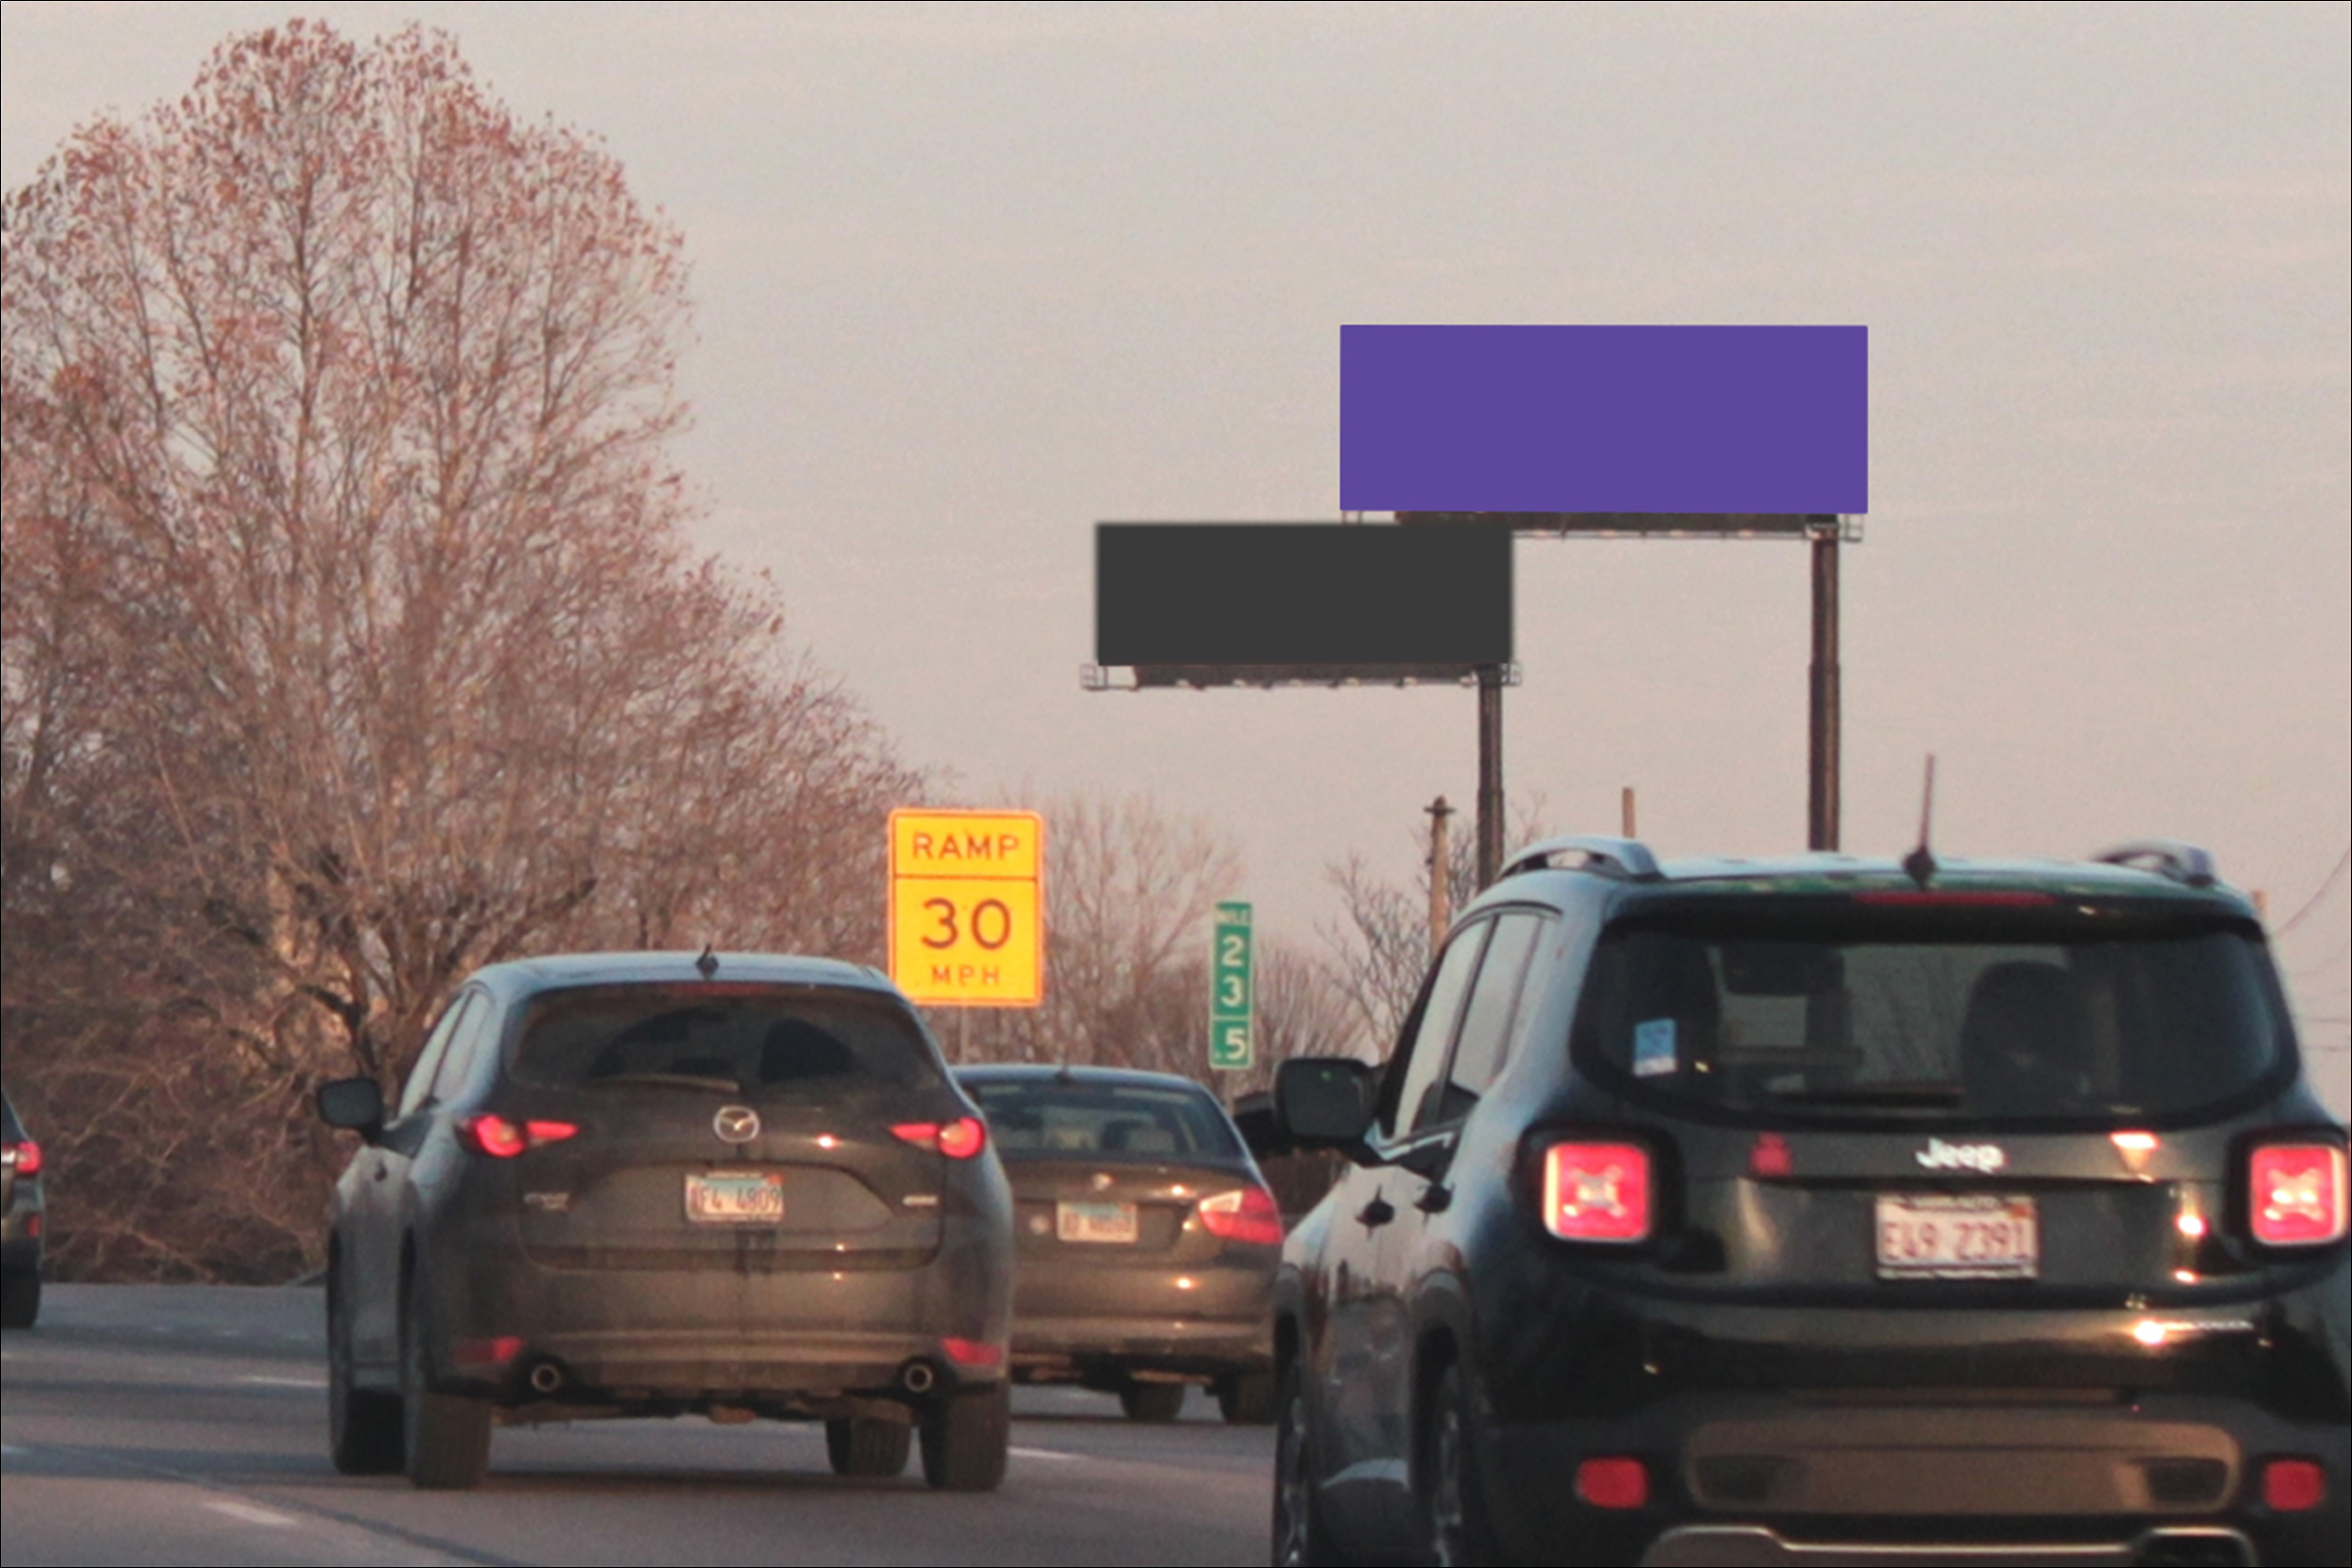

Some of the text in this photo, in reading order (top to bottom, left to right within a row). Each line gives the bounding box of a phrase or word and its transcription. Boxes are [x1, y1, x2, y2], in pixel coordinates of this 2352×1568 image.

[912, 830, 1020, 861] RAMP
[920, 897, 1012, 951] 30
[931, 964, 1001, 988] MPH
[1915, 1136, 2004, 1174] Jeep
